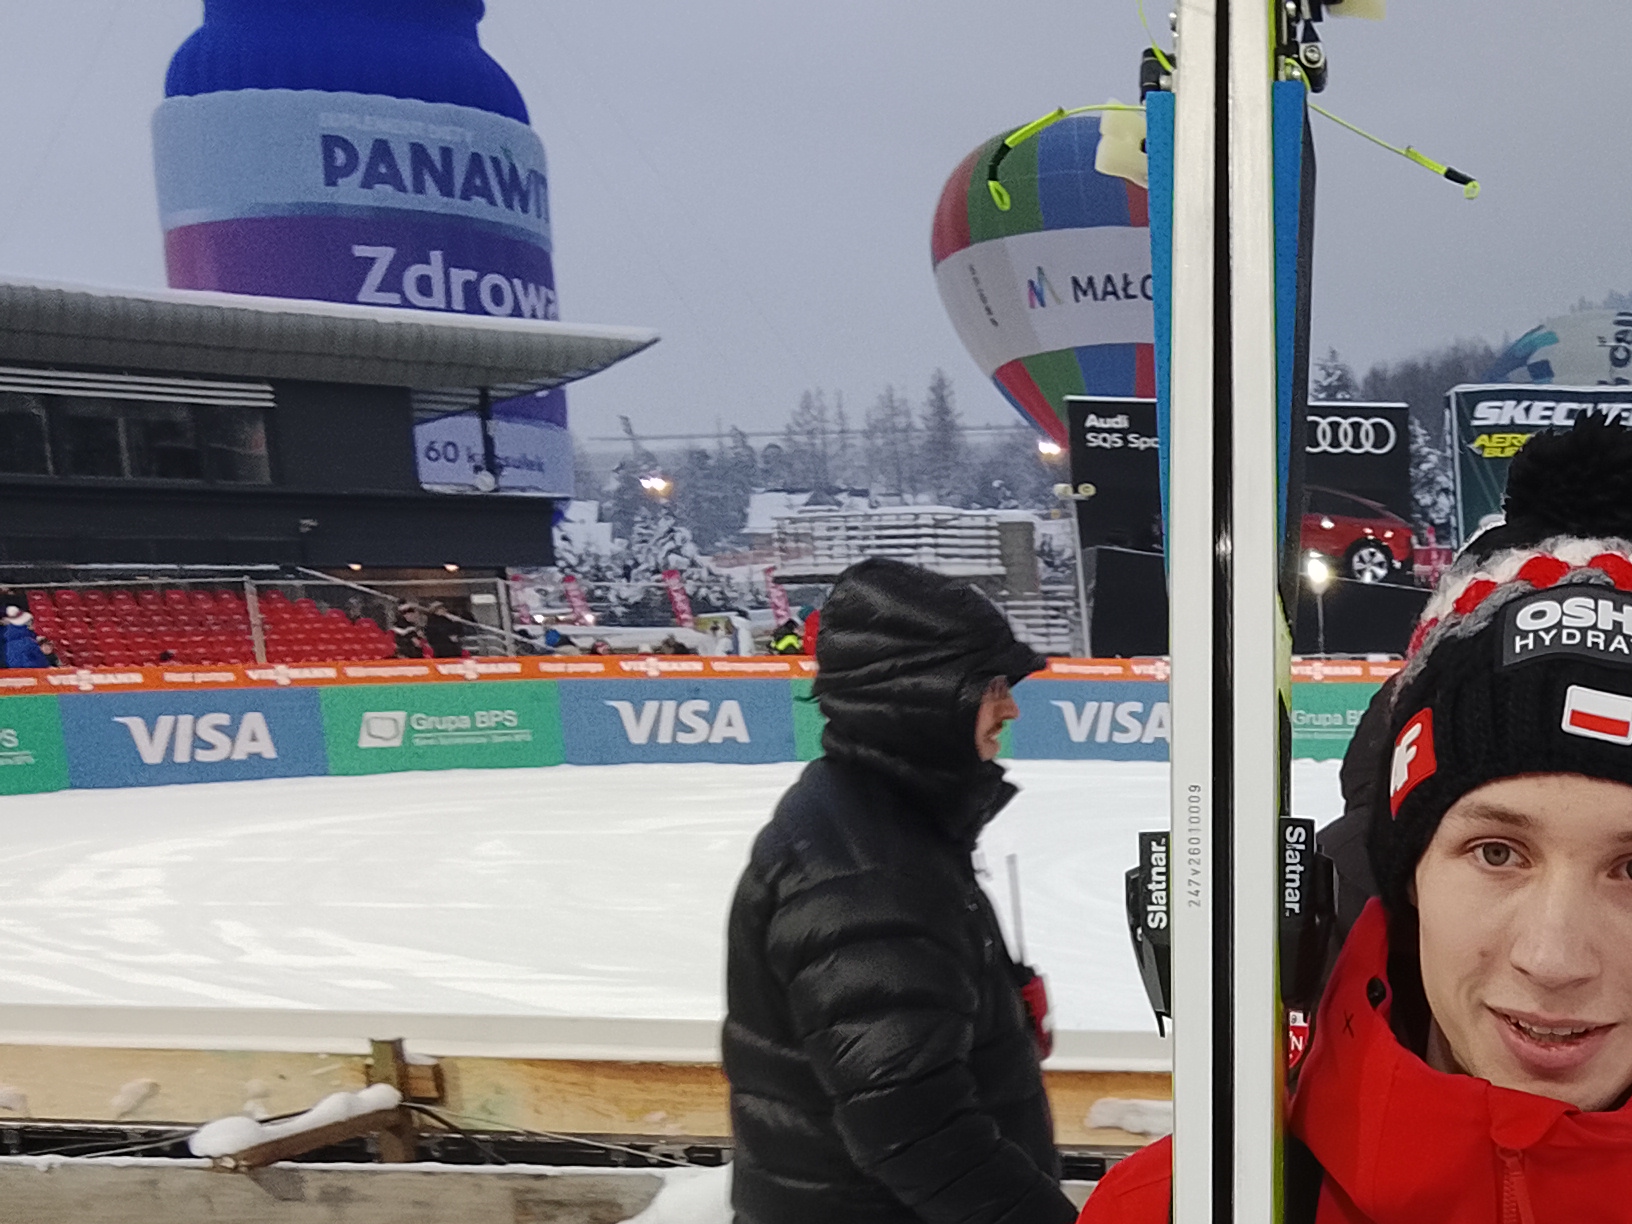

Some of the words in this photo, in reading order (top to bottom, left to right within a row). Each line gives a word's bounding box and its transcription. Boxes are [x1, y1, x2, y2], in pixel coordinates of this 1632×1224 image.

[1085, 413, 1129, 429] Audi
[425, 440, 460, 463] 60
[112, 711, 278, 765] VISA
[475, 709, 518, 727] BPS
[604, 699, 751, 744] VISA
[1050, 700, 1172, 744] VISA
[1187, 784, 1202, 908] 247v26010009
